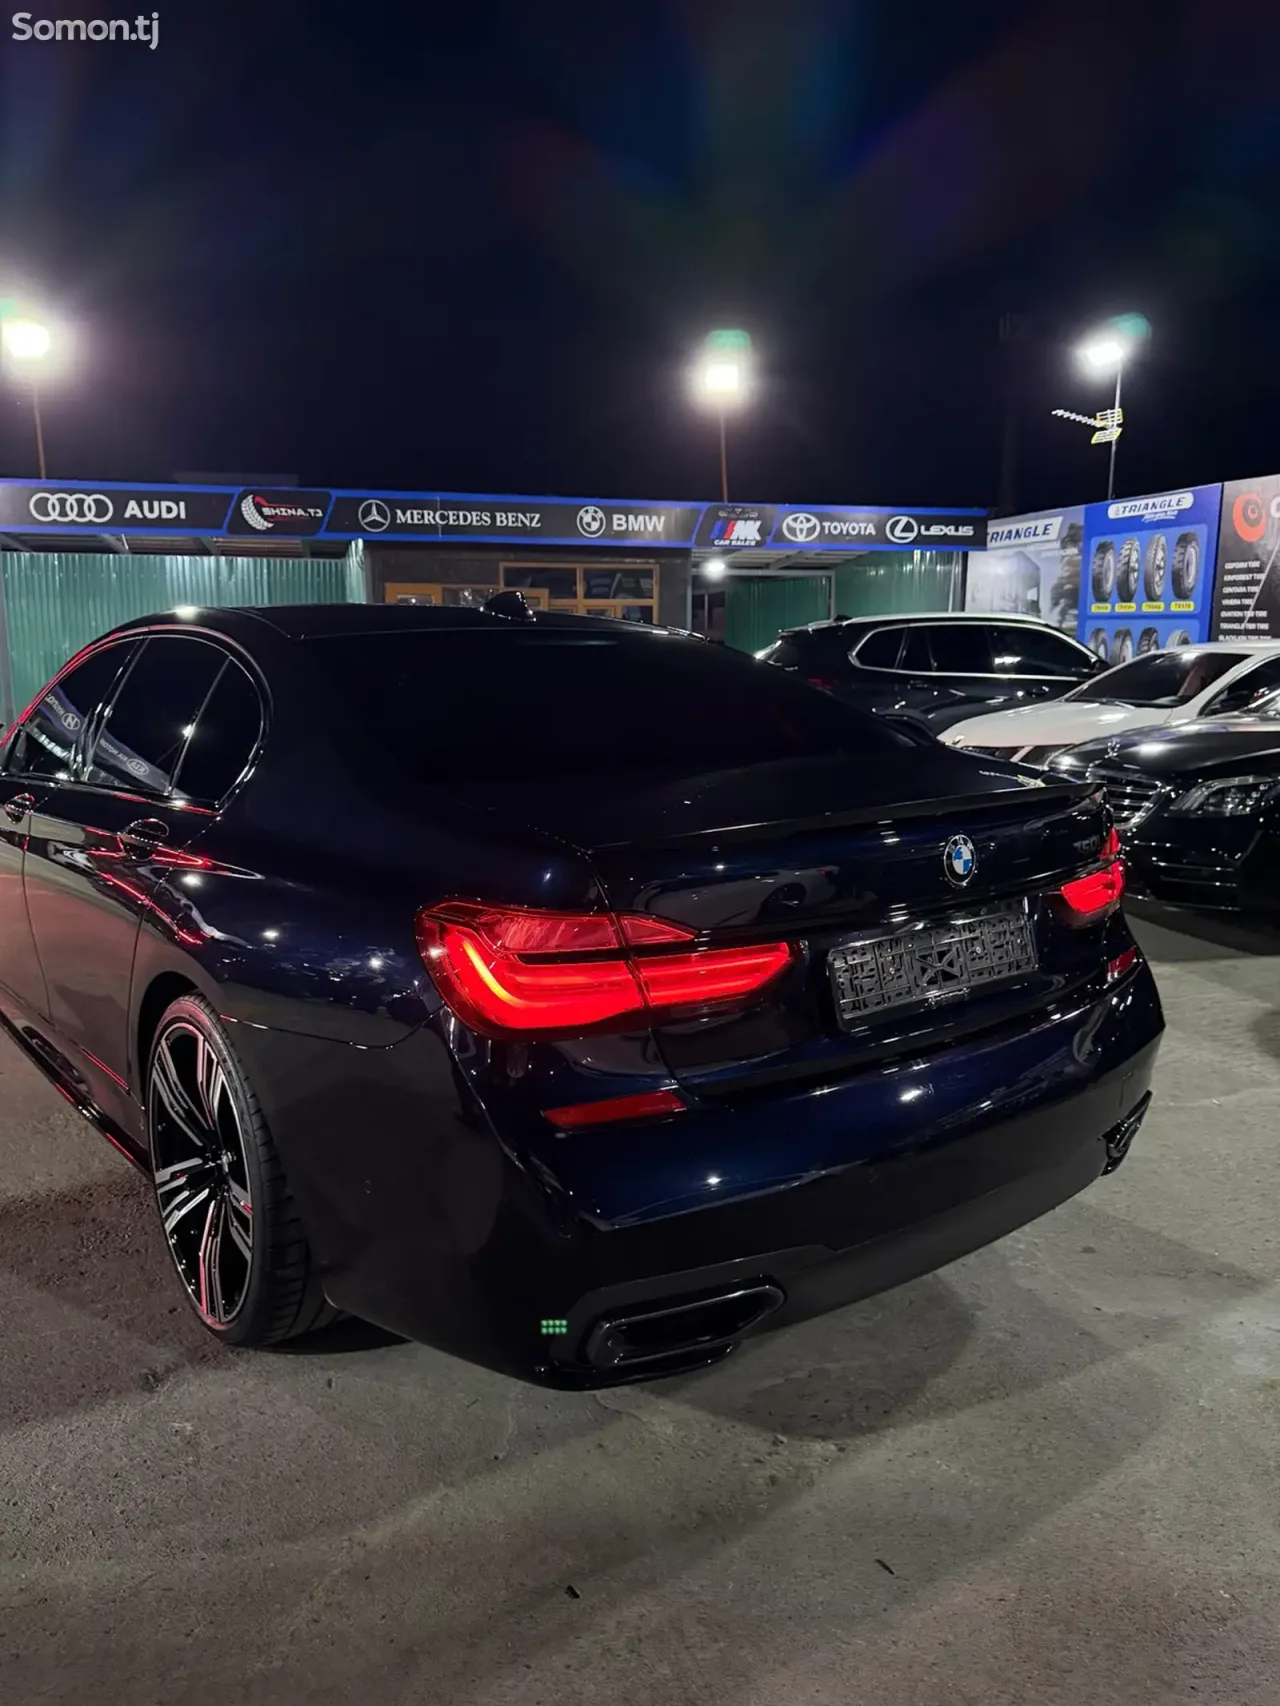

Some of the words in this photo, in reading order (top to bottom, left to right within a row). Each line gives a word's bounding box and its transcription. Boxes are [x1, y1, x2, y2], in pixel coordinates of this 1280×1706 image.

[124, 499, 186, 520] AUDI
[262, 507, 323, 517] SHINA.TJ
[1120, 496, 1187, 515] TRIANGLE
[395, 508, 492, 526] MERCEDES
[496, 511, 541, 528] BENZ
[612, 514, 665, 532] BMW
[822, 521, 876, 536] TOYOTA
[920, 524, 974, 536] LEXUS
[987, 523, 1053, 543] RIANGLE
